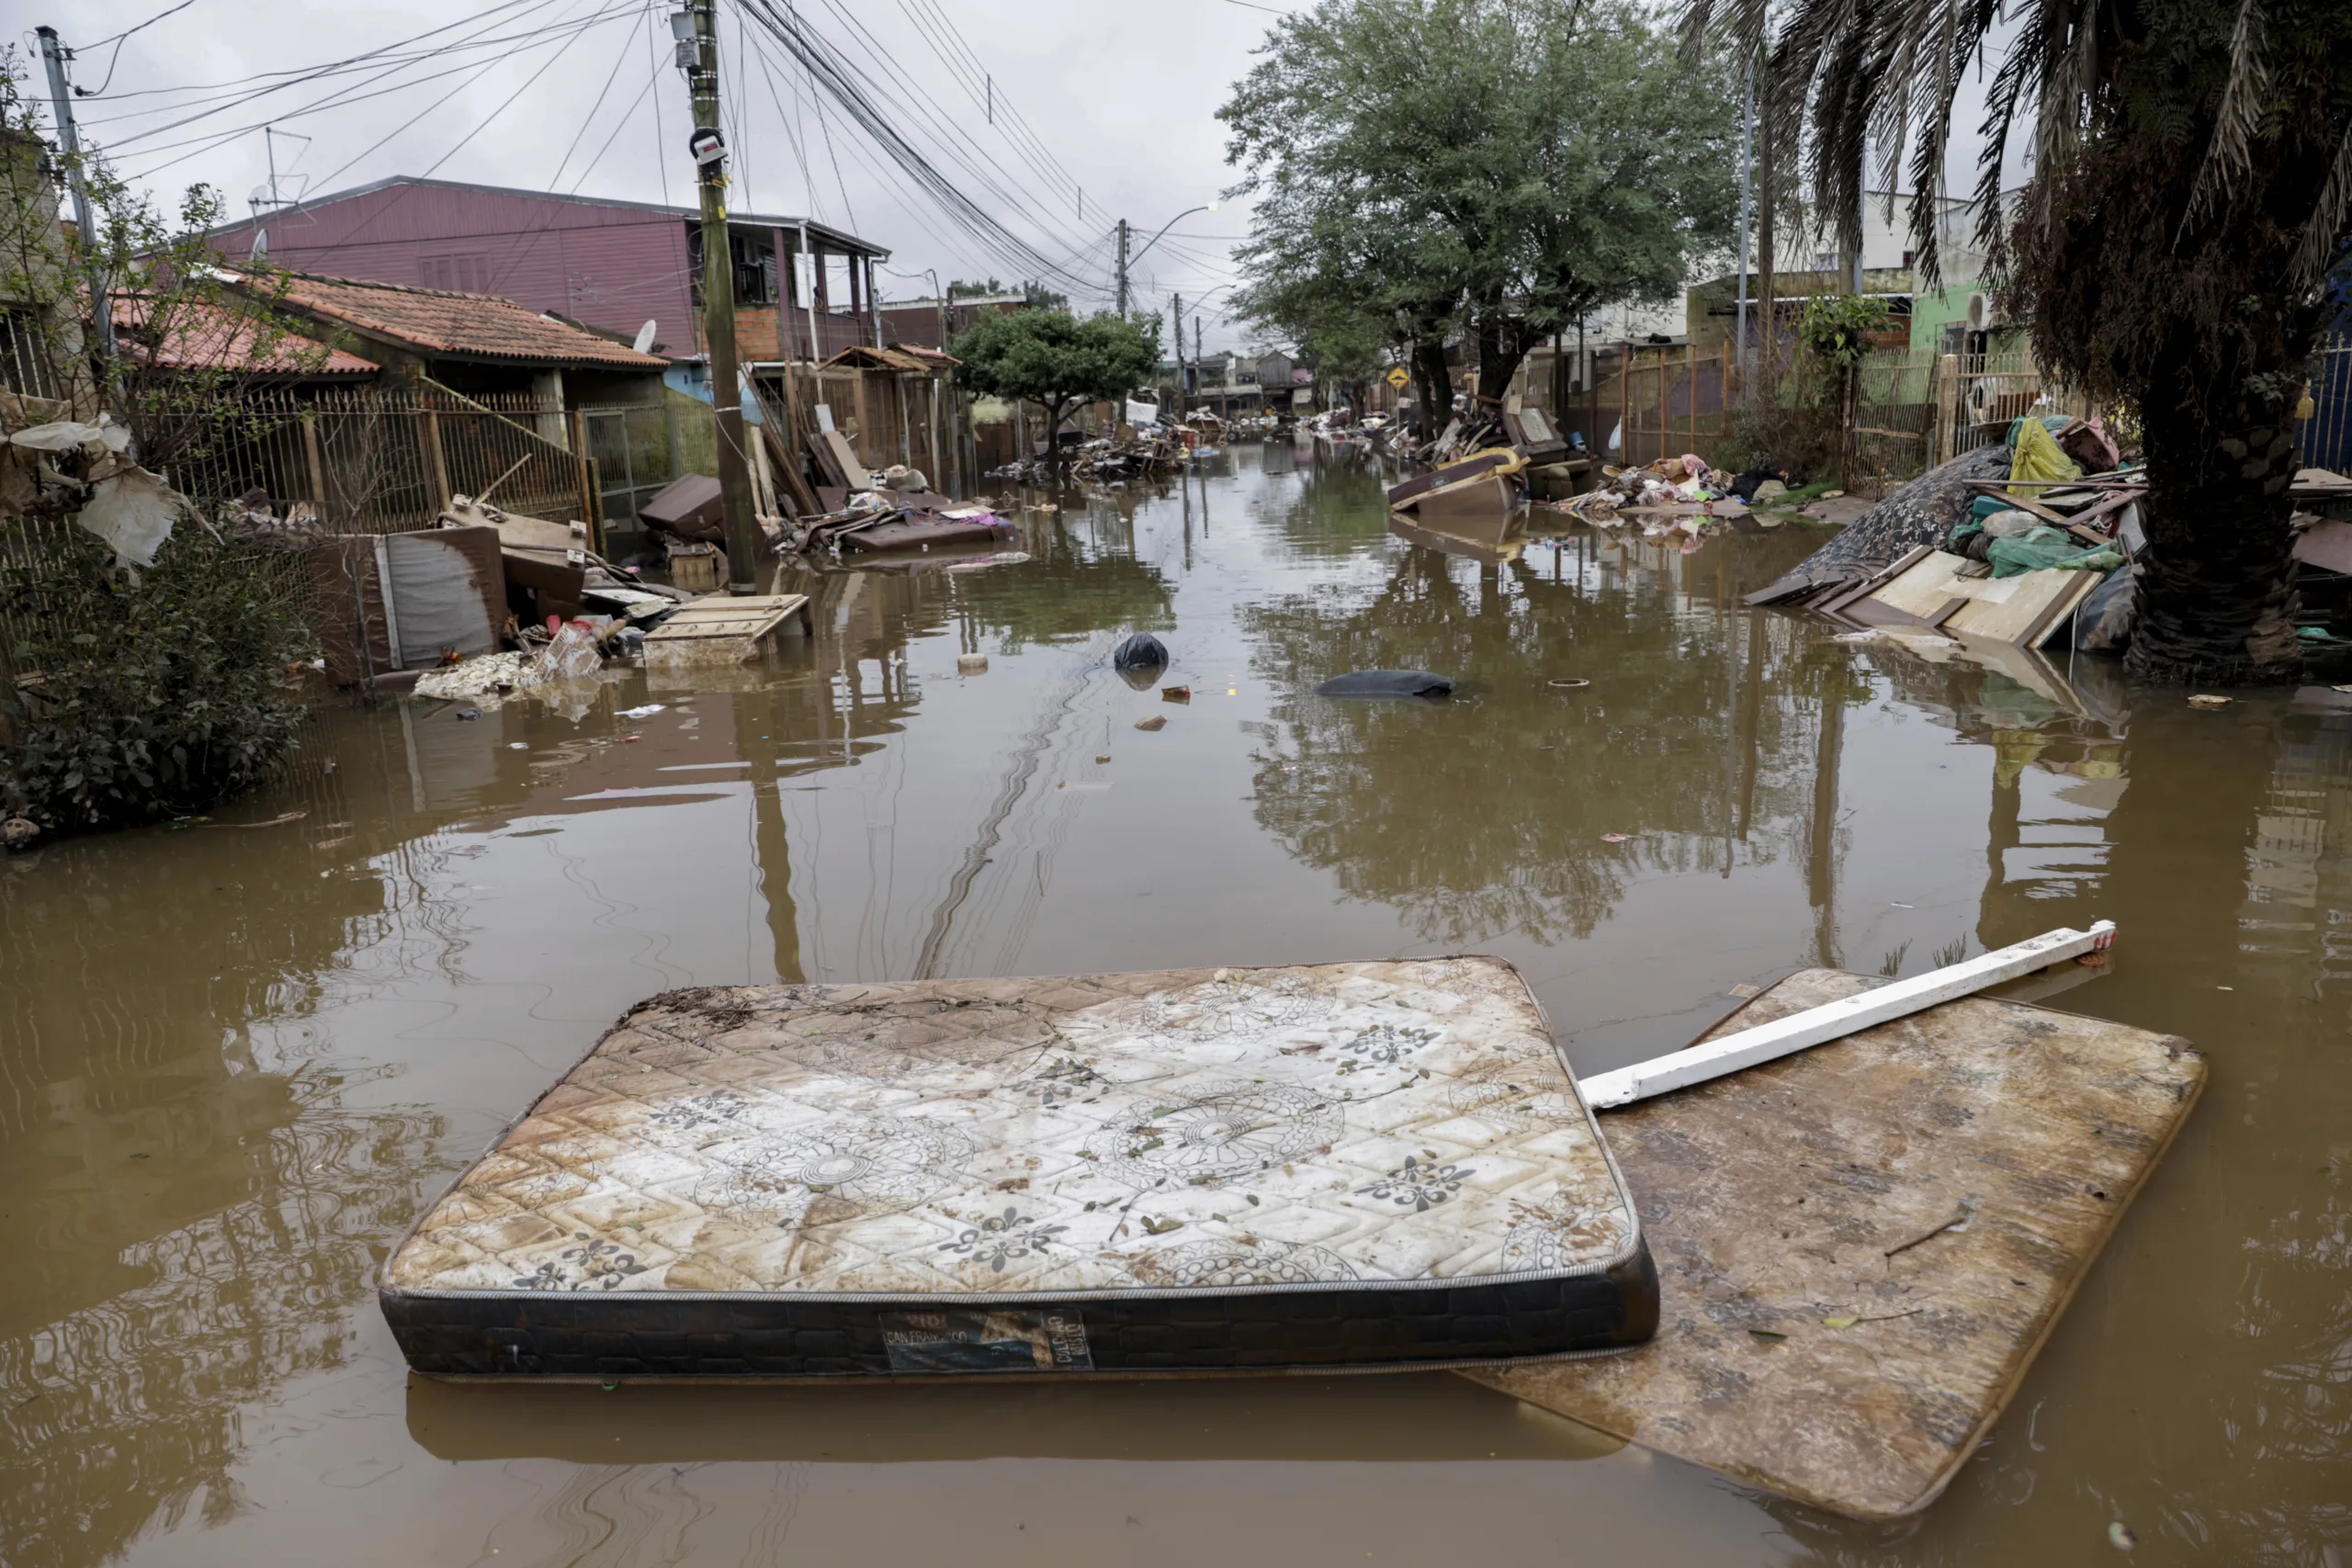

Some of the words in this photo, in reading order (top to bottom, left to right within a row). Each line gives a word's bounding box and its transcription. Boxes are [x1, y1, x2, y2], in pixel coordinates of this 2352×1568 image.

[887, 1330, 908, 1343] SAN
[909, 1329, 967, 1343] FRANSCO
[1064, 1323, 1086, 1356] MISTO
